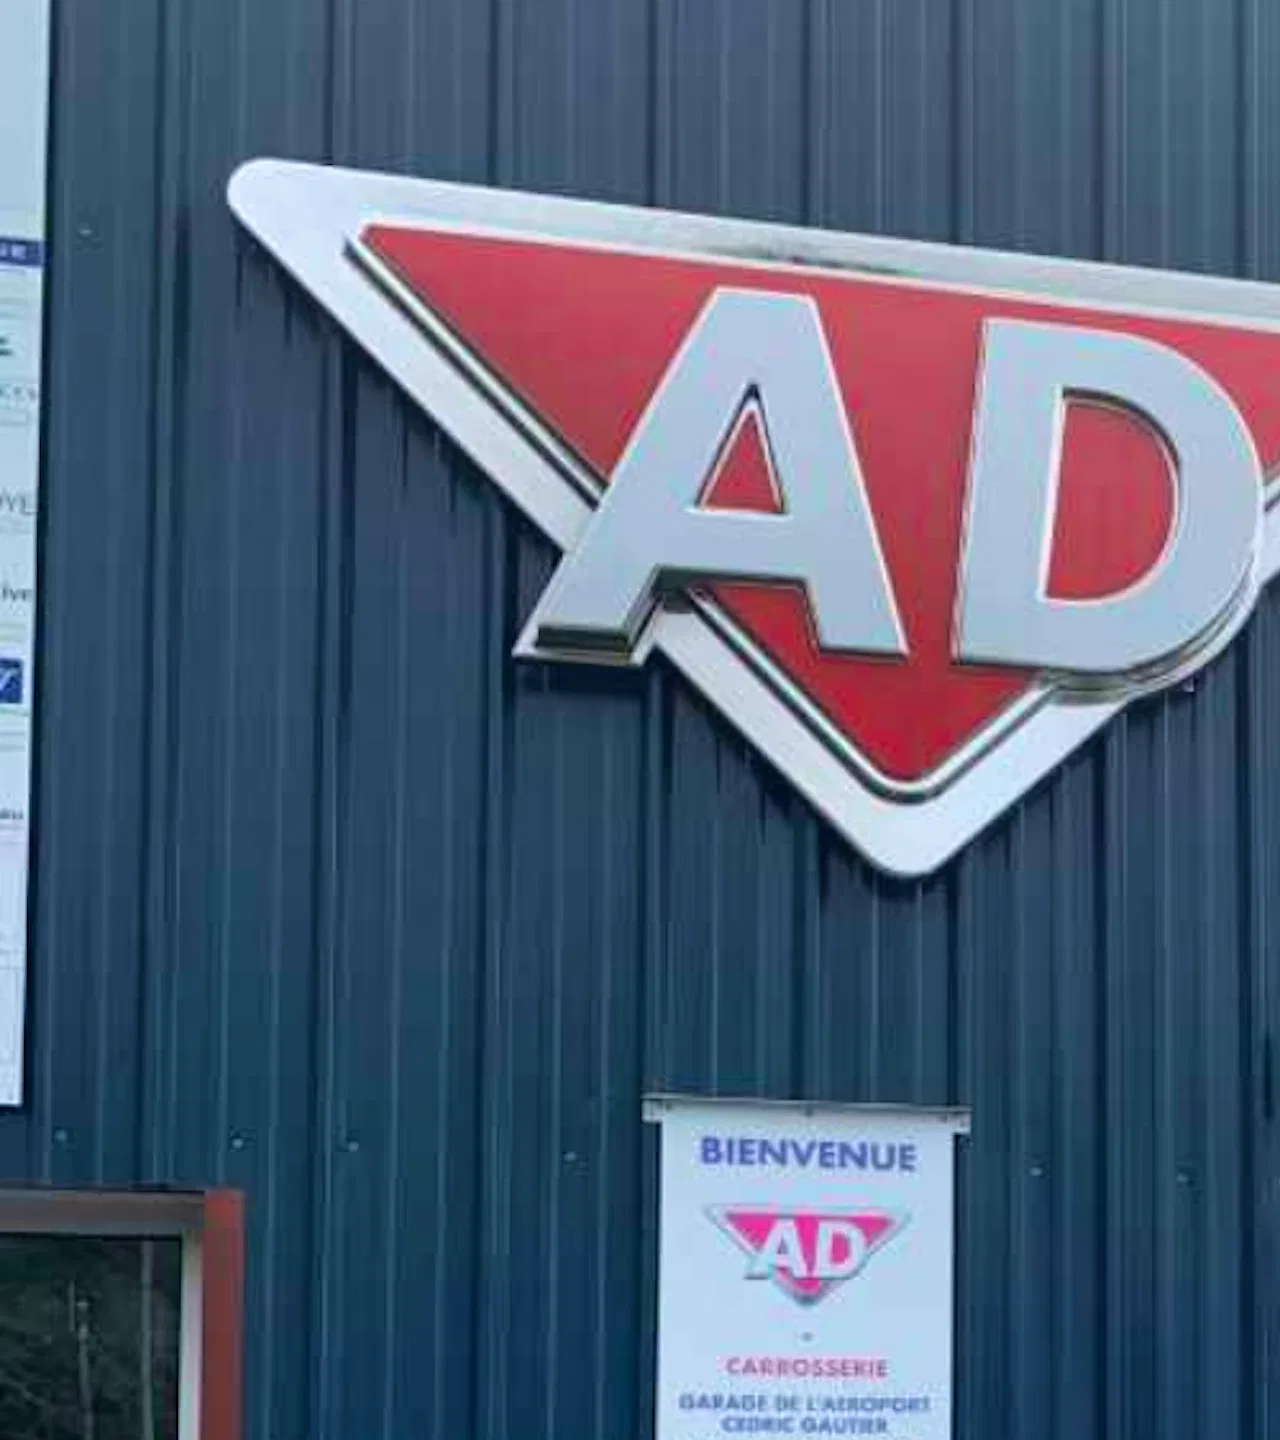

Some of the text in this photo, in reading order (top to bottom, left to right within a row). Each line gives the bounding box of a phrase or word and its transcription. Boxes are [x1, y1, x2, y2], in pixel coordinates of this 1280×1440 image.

[517, 286, 1266, 692] AD
[701, 1135, 918, 1172] BIENVENUE
[743, 1216, 868, 1280] AD
[726, 1355, 890, 1379] CARROSSERIE
[678, 1392, 768, 1413] GARAGE
[775, 1394, 800, 1413] DE
[720, 1416, 889, 1434] CEDRIC GAUTIER
